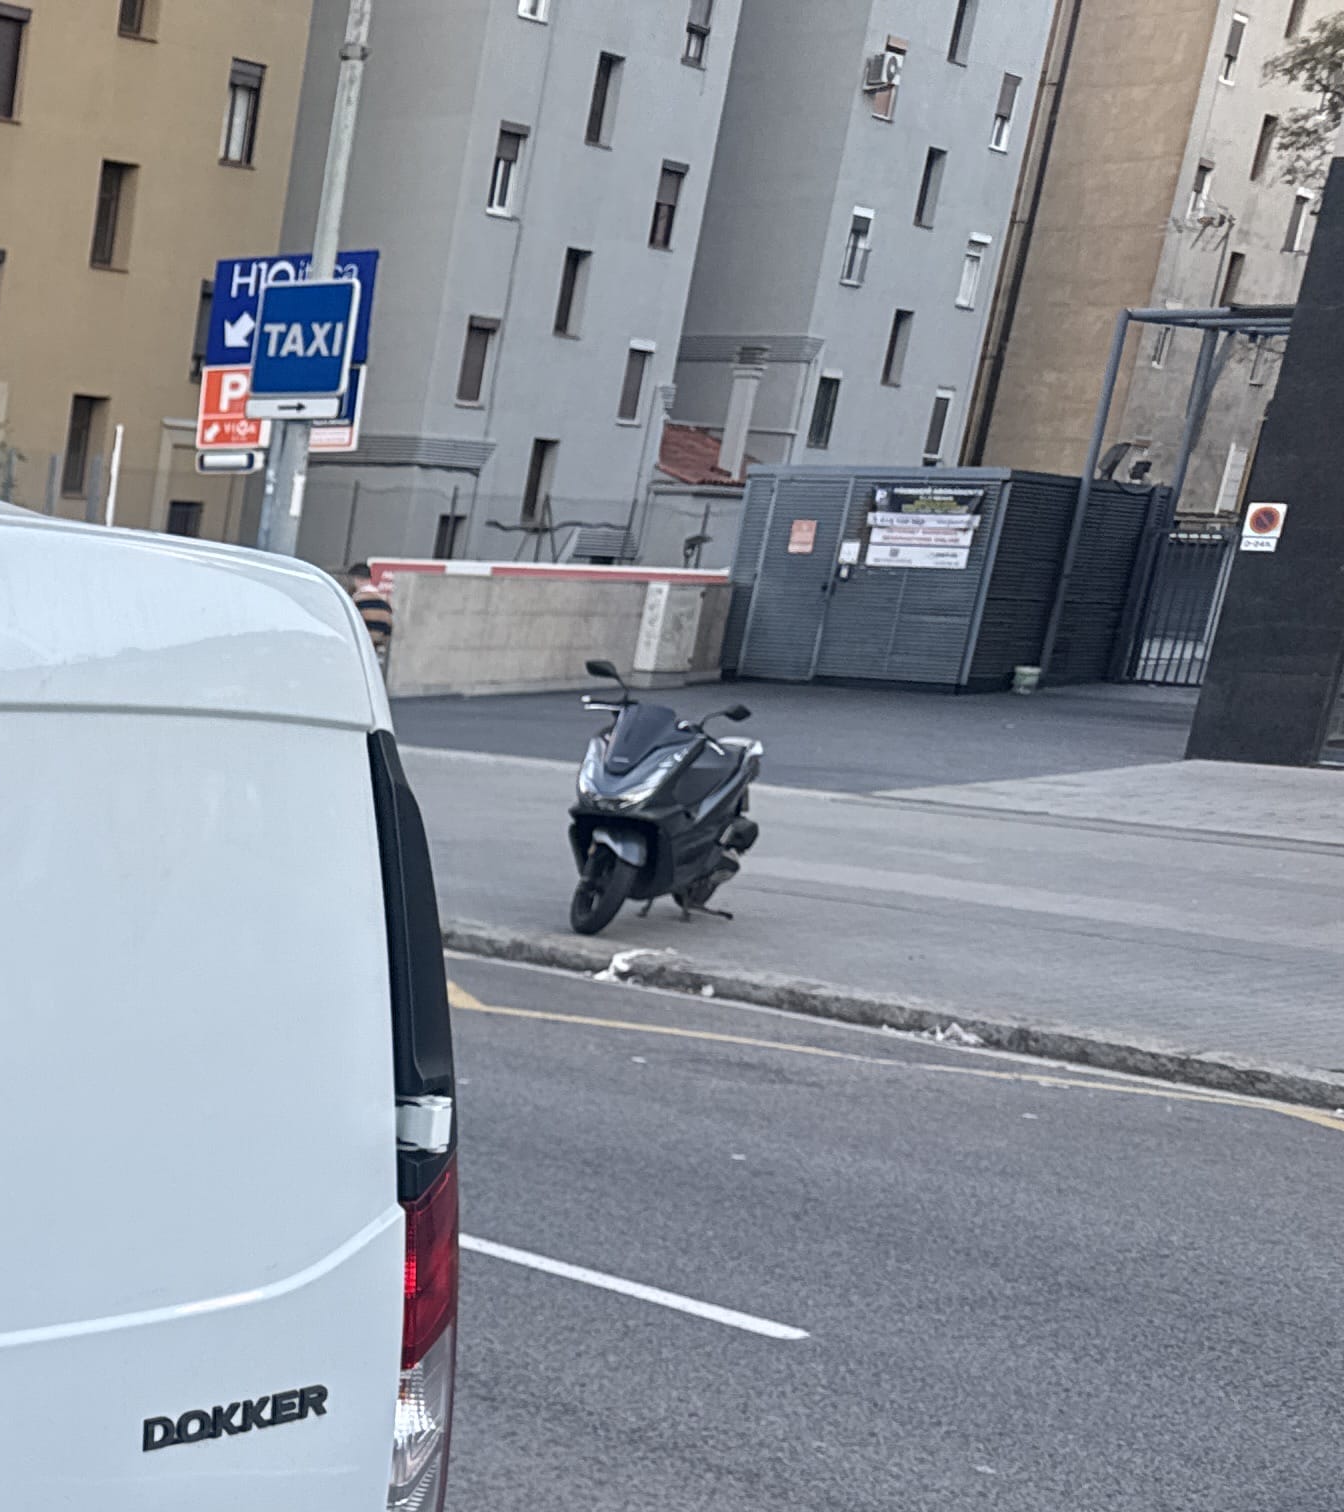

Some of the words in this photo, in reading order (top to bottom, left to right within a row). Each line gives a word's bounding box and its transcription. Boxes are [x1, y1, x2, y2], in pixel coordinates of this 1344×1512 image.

[263, 322, 344, 357] TAXI
[219, 373, 248, 412] P
[142, 1384, 328, 1452] DOKKER
